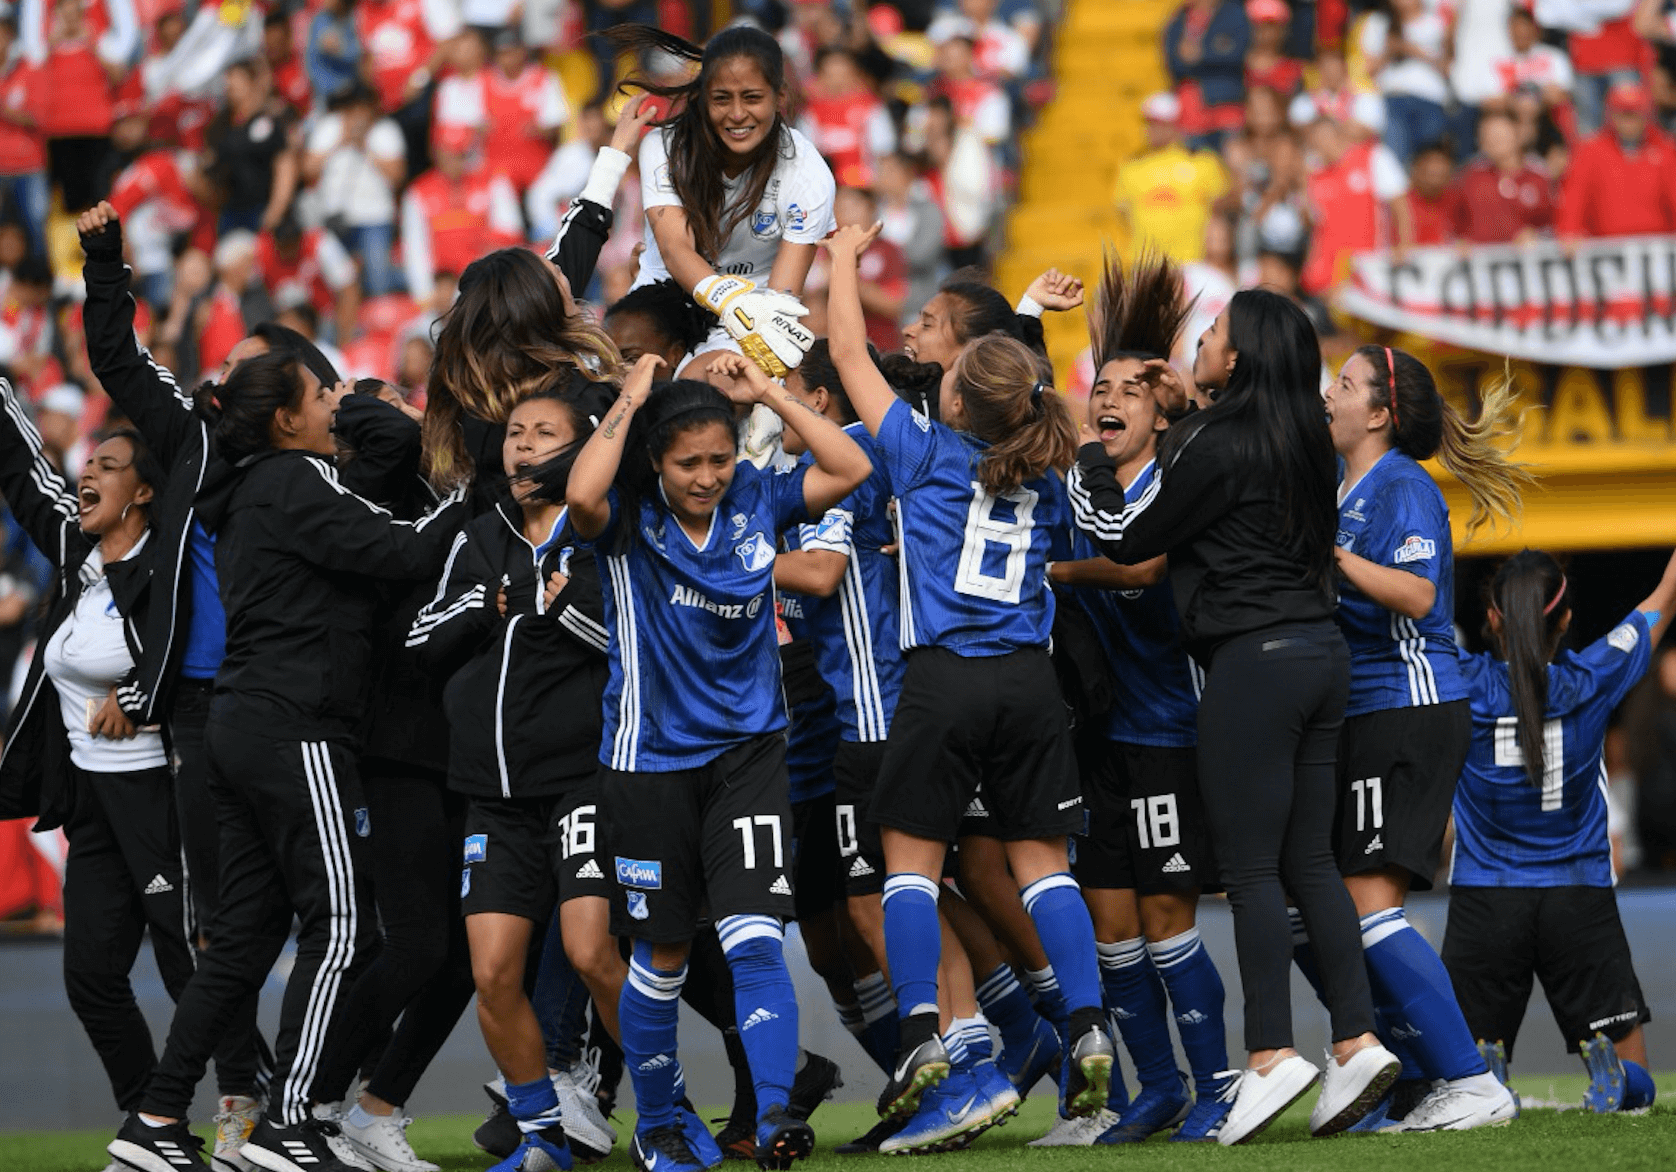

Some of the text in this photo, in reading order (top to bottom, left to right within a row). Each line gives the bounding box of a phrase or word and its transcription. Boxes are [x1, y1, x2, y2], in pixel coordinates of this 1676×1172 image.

[772, 316, 811, 343] RINAT
[954, 480, 1040, 605] 8
[670, 584, 744, 619] Allianz
[1494, 715, 1563, 812] 4
[1130, 793, 1181, 849] 18
[1351, 776, 1384, 831] 11
[558, 804, 597, 860] 16
[732, 814, 785, 870] 17
